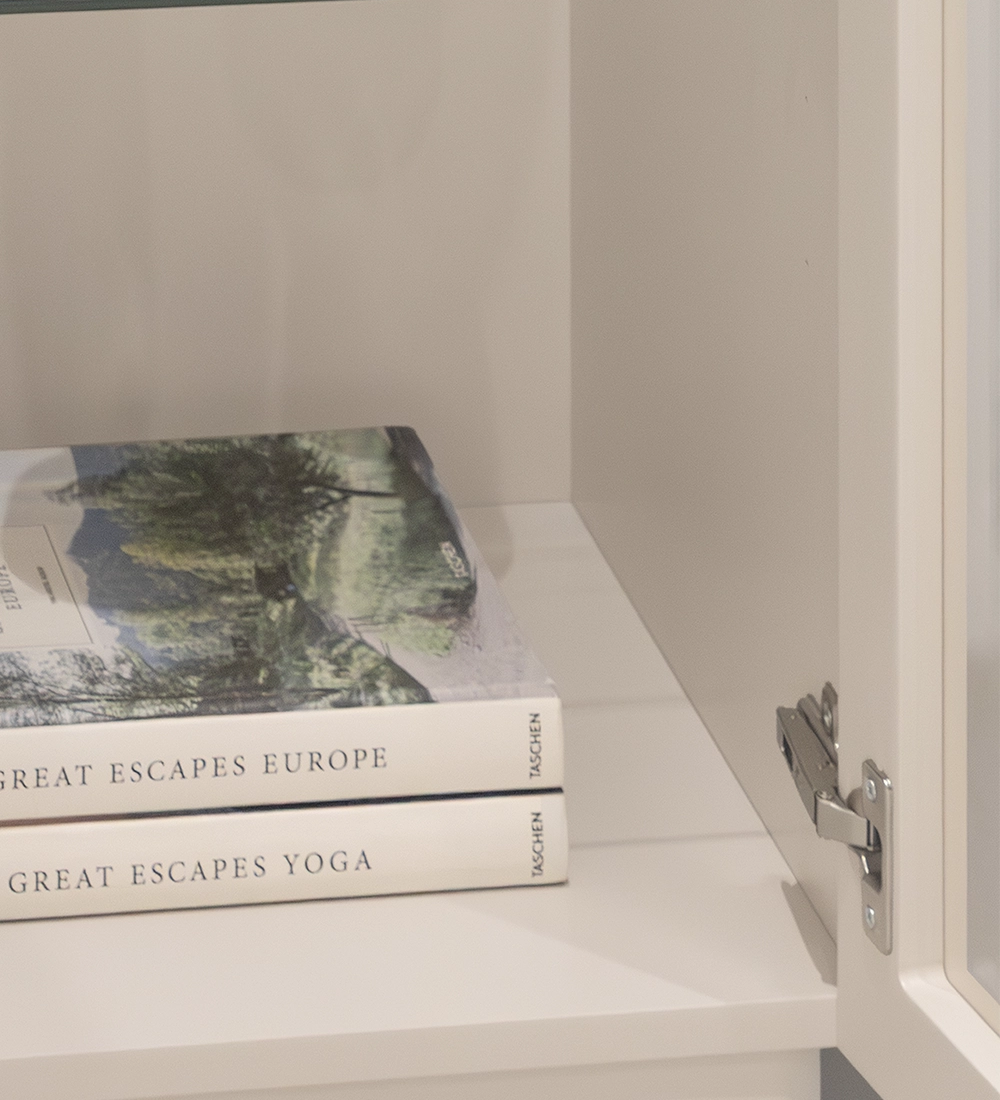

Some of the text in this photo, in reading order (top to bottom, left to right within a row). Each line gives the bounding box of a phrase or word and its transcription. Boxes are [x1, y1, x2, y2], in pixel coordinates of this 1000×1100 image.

[110, 754, 247, 784] ESCAPES
[263, 747, 388, 775] EUROPE
[529, 712, 541, 780] TASCHEN
[8, 850, 373, 894] GREAT ESCAPES YOGA
[531, 811, 544, 879] TASCHEN
